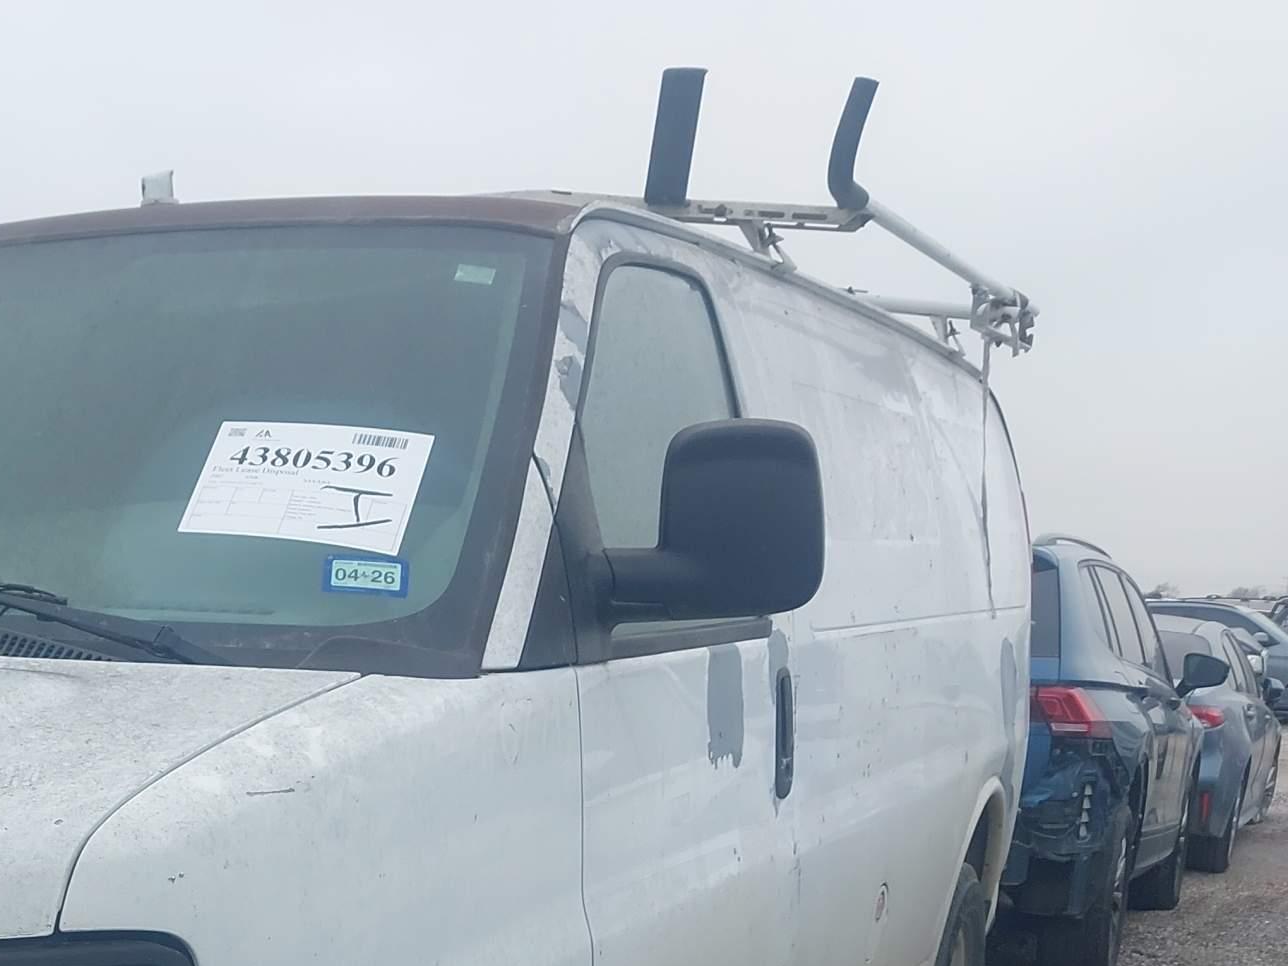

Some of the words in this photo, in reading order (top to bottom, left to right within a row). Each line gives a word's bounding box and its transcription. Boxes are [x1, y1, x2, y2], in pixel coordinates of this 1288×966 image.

[229, 445, 400, 478] 43805396
[334, 567, 360, 582] 04
[370, 569, 396, 585] 26
